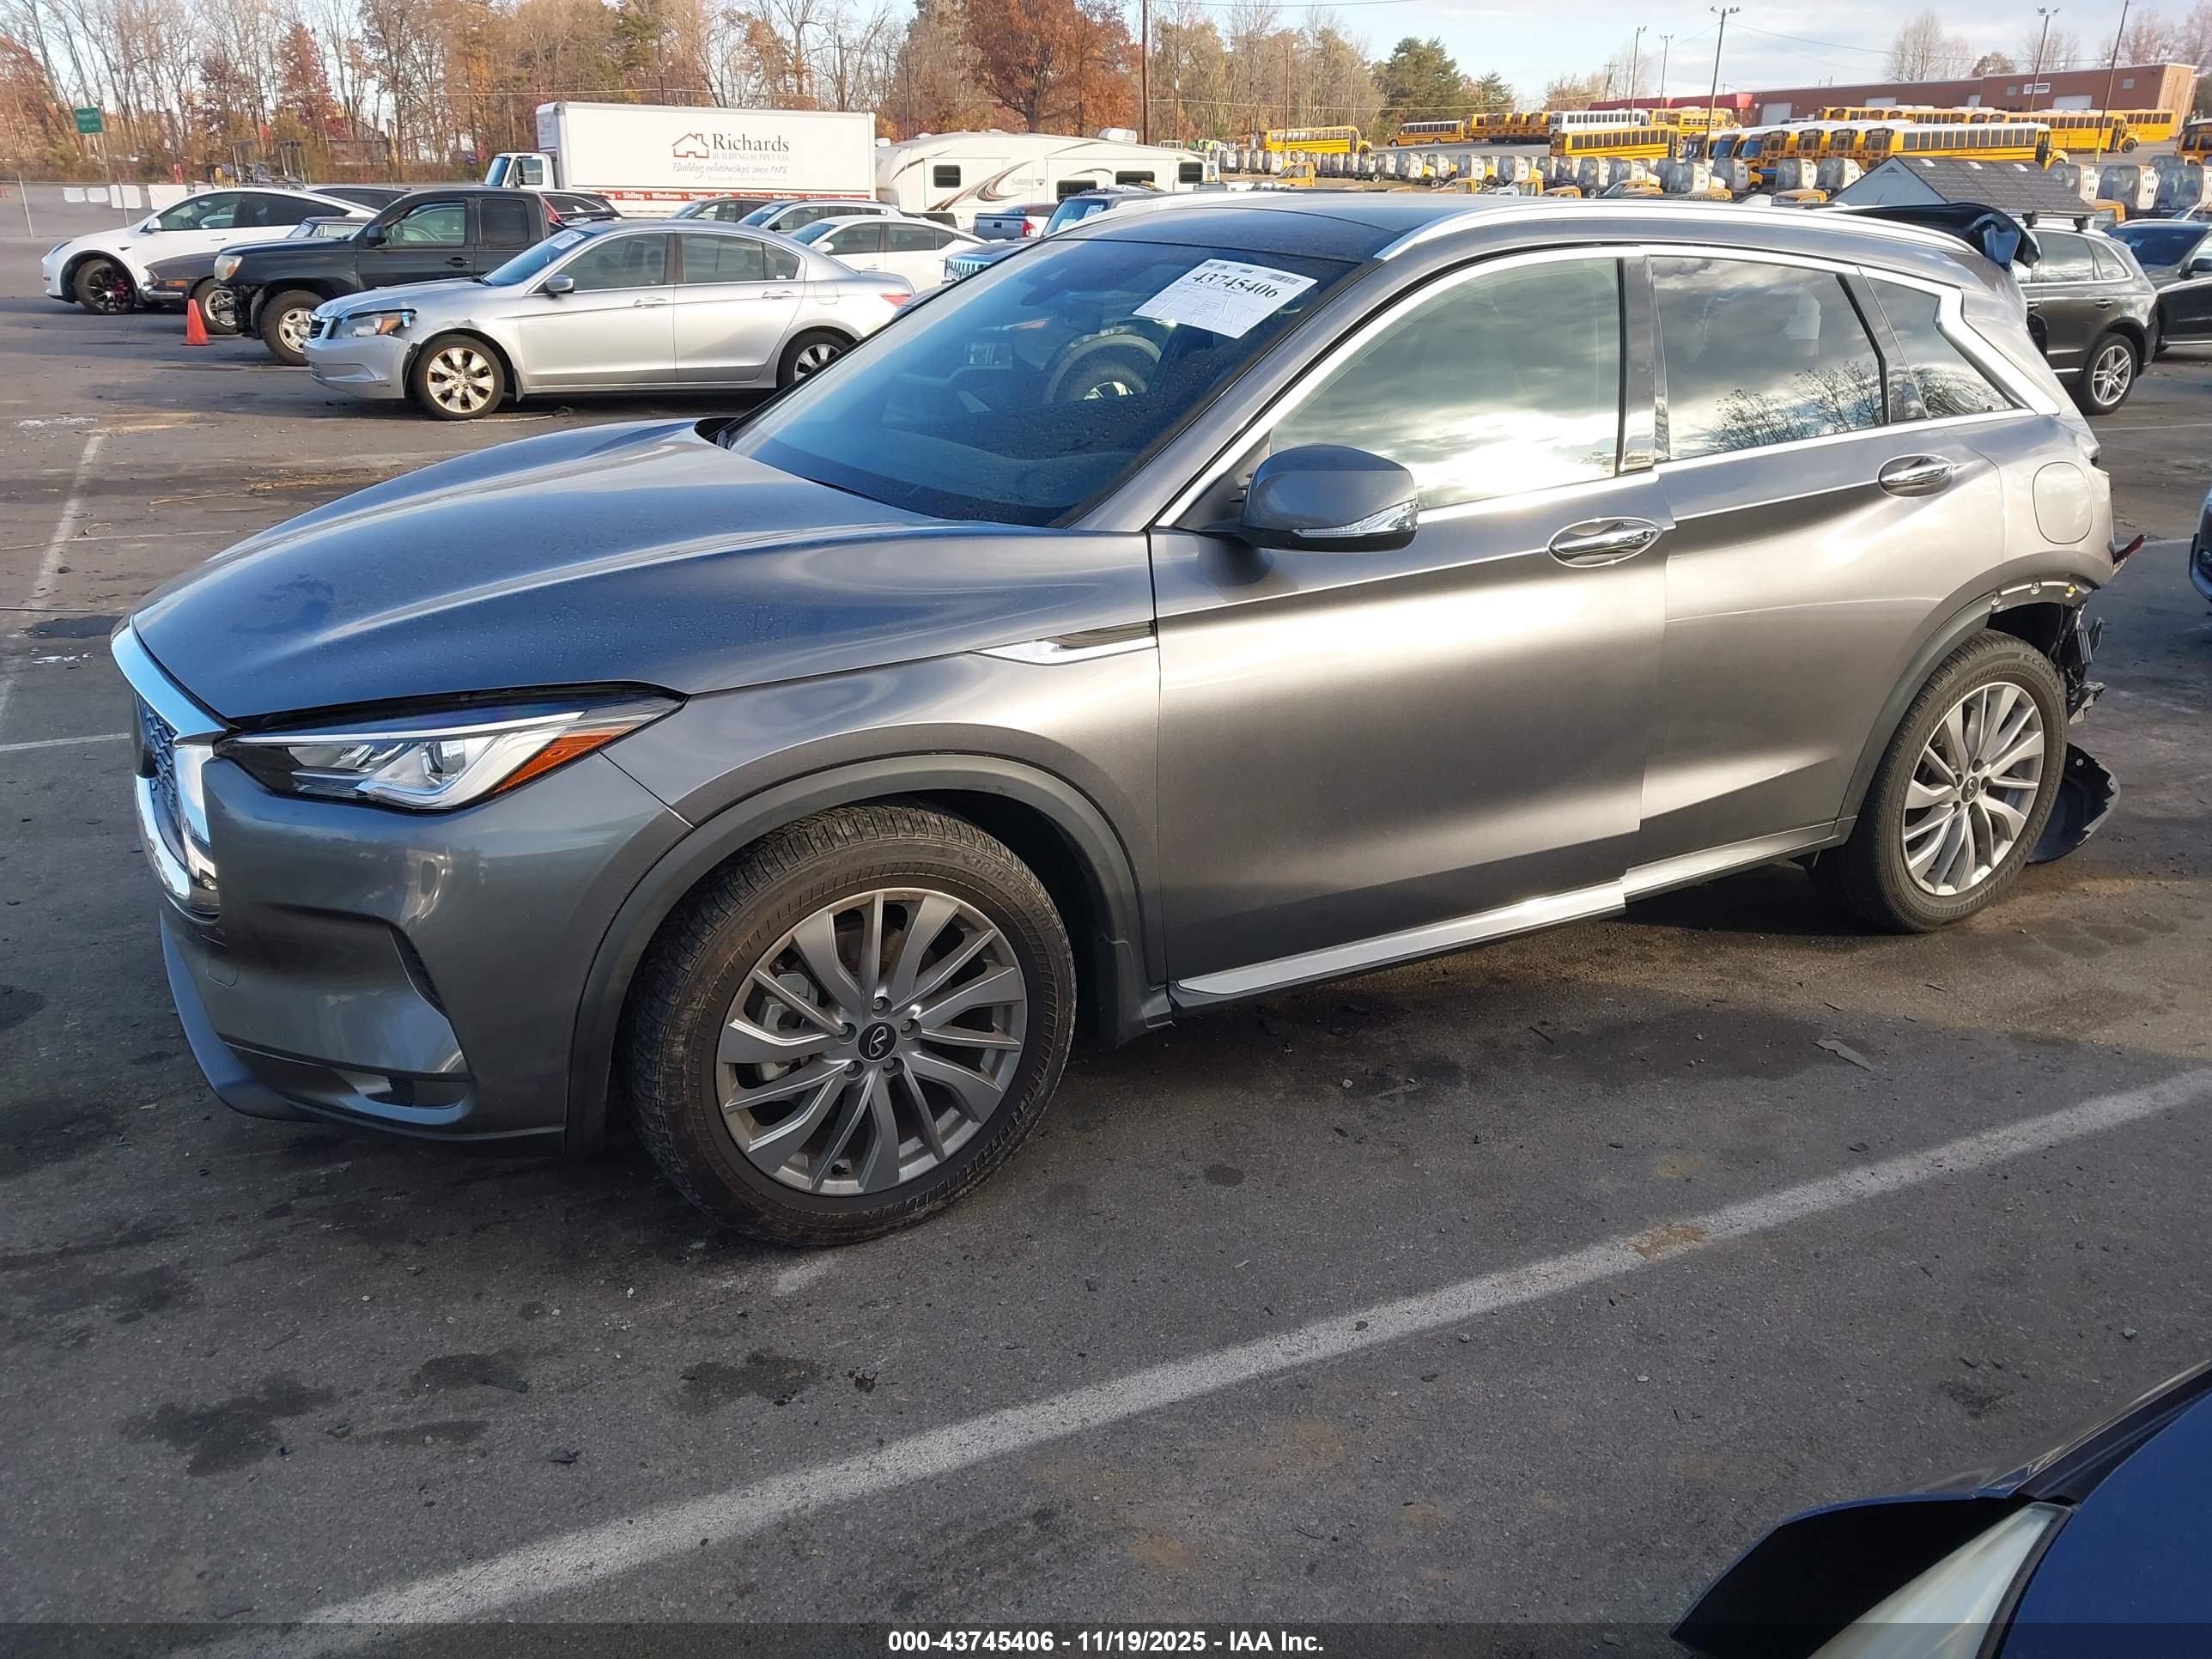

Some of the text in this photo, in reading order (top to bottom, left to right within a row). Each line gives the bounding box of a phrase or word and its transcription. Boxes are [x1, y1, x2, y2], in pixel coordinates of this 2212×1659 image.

[713, 133, 789, 152] Richards
[672, 162, 704, 179] Building
[706, 162, 750, 177] relationships
[751, 166, 769, 174] since
[623, 191, 645, 201] Siding
[1193, 272, 1285, 298] 43745406
